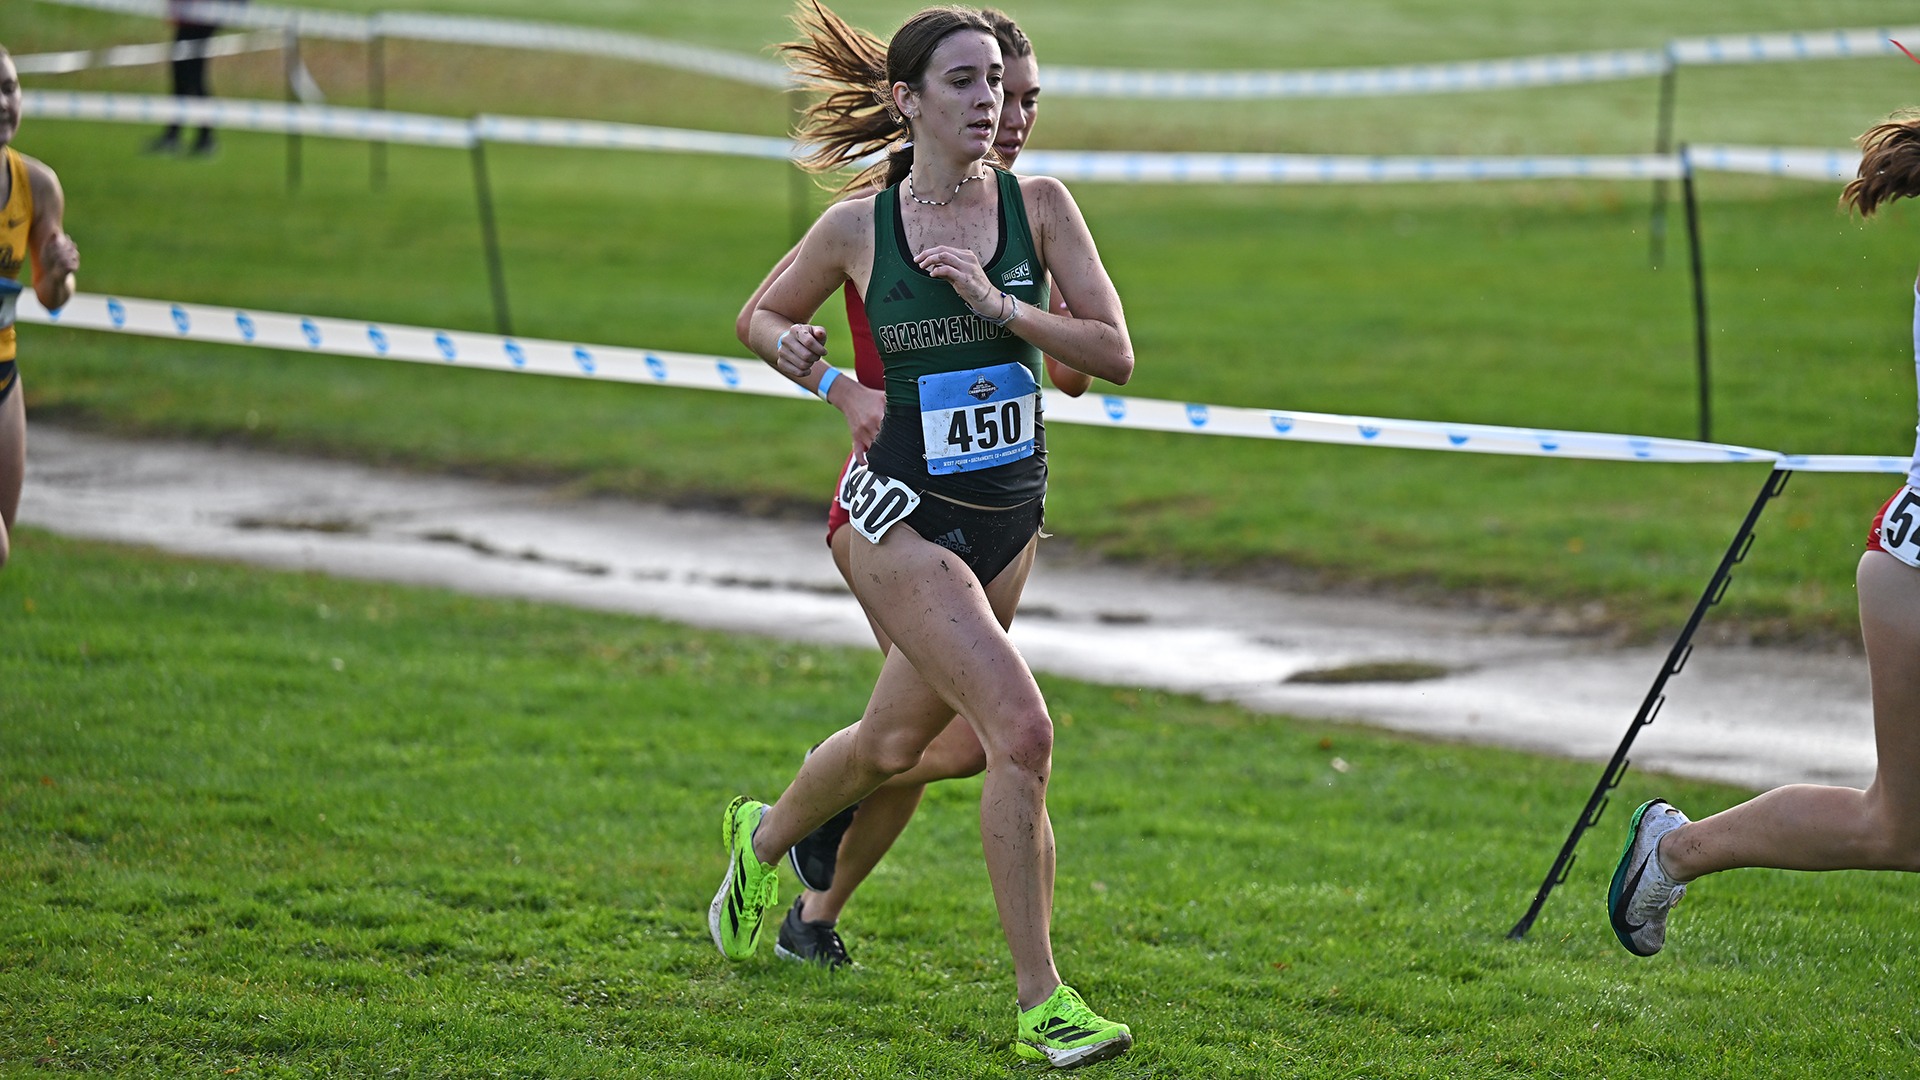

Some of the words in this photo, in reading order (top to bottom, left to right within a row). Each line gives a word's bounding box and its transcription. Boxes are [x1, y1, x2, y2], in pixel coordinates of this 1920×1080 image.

[879, 315, 998, 354] SACRAMENTO
[947, 401, 1022, 453] 450
[850, 471, 909, 534] 450
[934, 538, 971, 553] adidas
